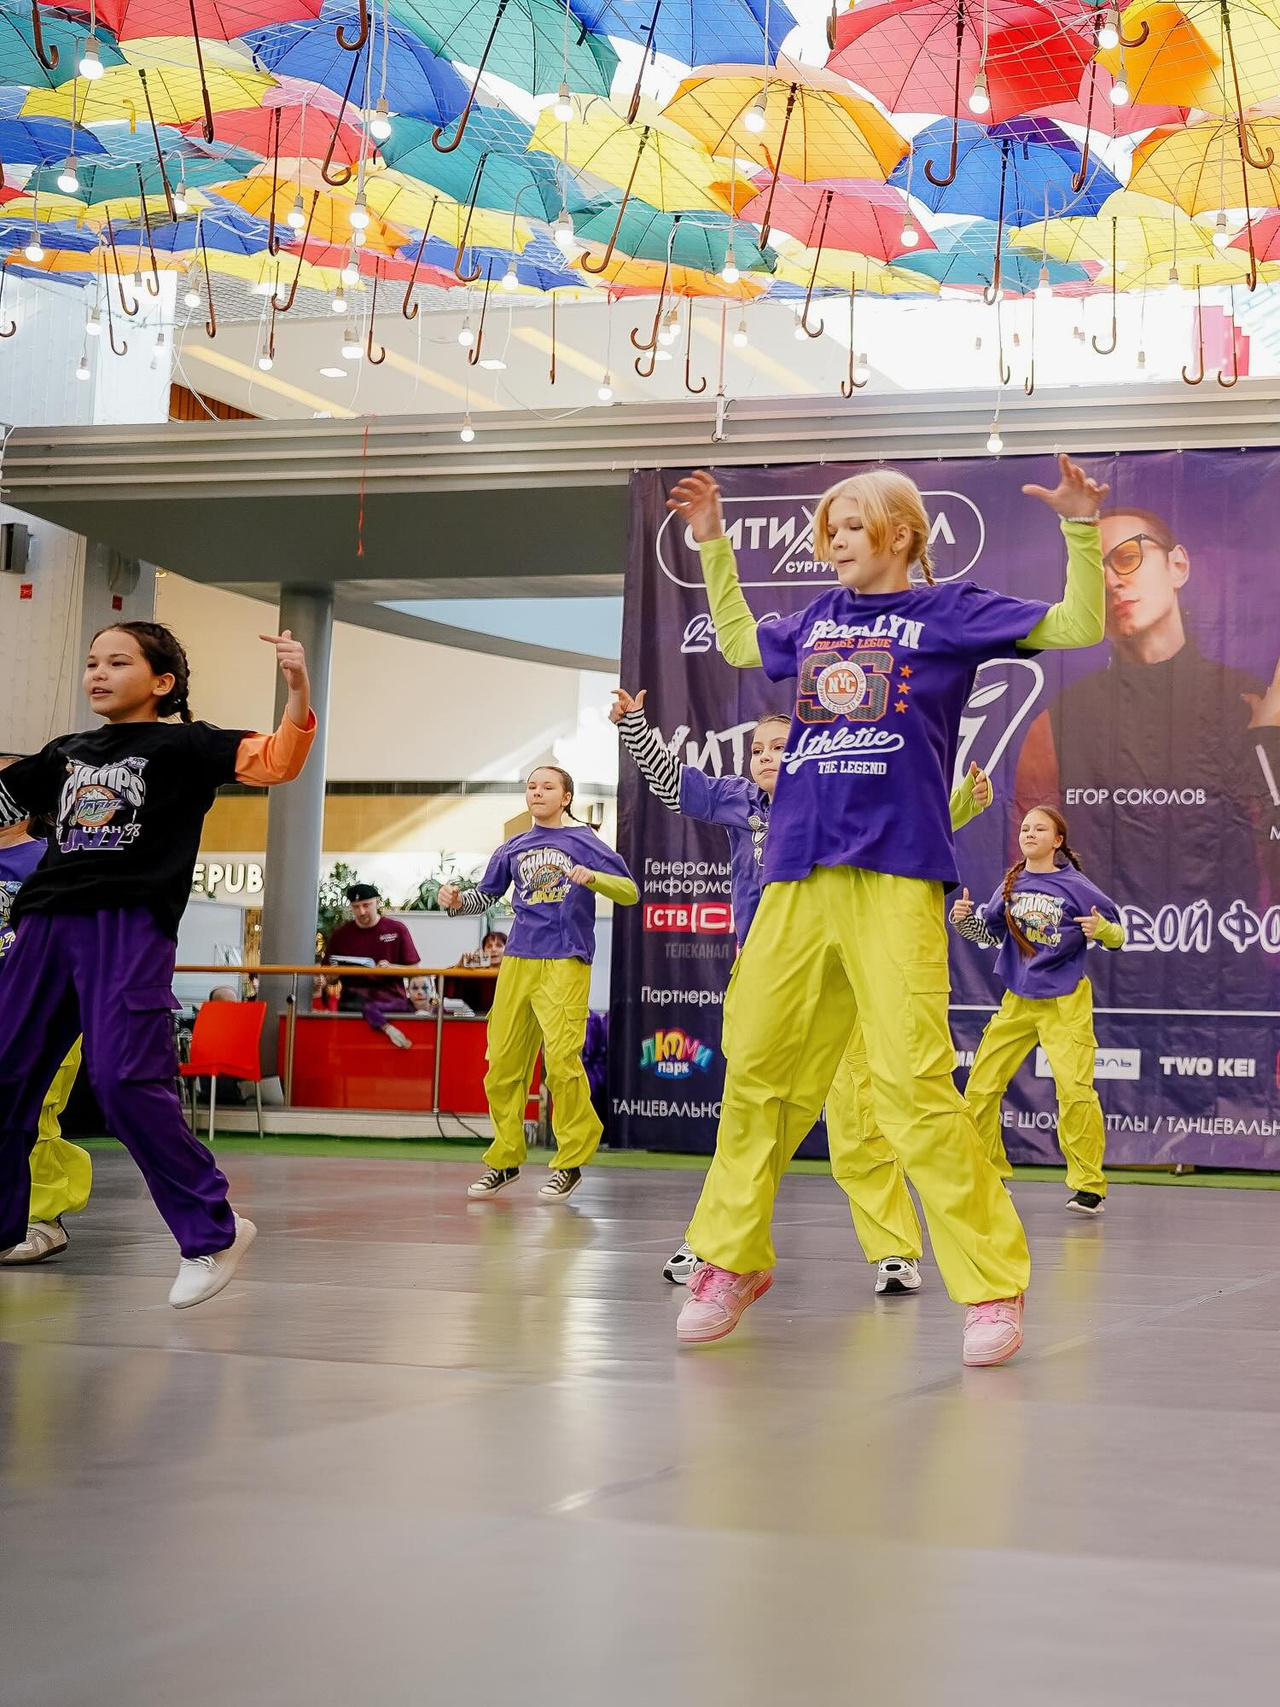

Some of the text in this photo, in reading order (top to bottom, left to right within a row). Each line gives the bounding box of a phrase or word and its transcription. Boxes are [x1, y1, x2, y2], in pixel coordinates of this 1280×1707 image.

[857, 638, 893, 648] LEGUE
[828, 672, 856, 693] NYC
[782, 727, 905, 774] Athletic
[818, 761, 887, 775] THE LEGEND
[1066, 788, 1206, 805] ЕГОР СОКОЛОВ
[82, 826, 121, 834] UTAH
[665, 942, 729, 959] ТЕЛЕКАНАЛ
[658, 1061, 690, 1076] парк
[1159, 1056, 1256, 1077] TWO KEI
[1105, 1114, 1149, 1132] ТТЛЫ
